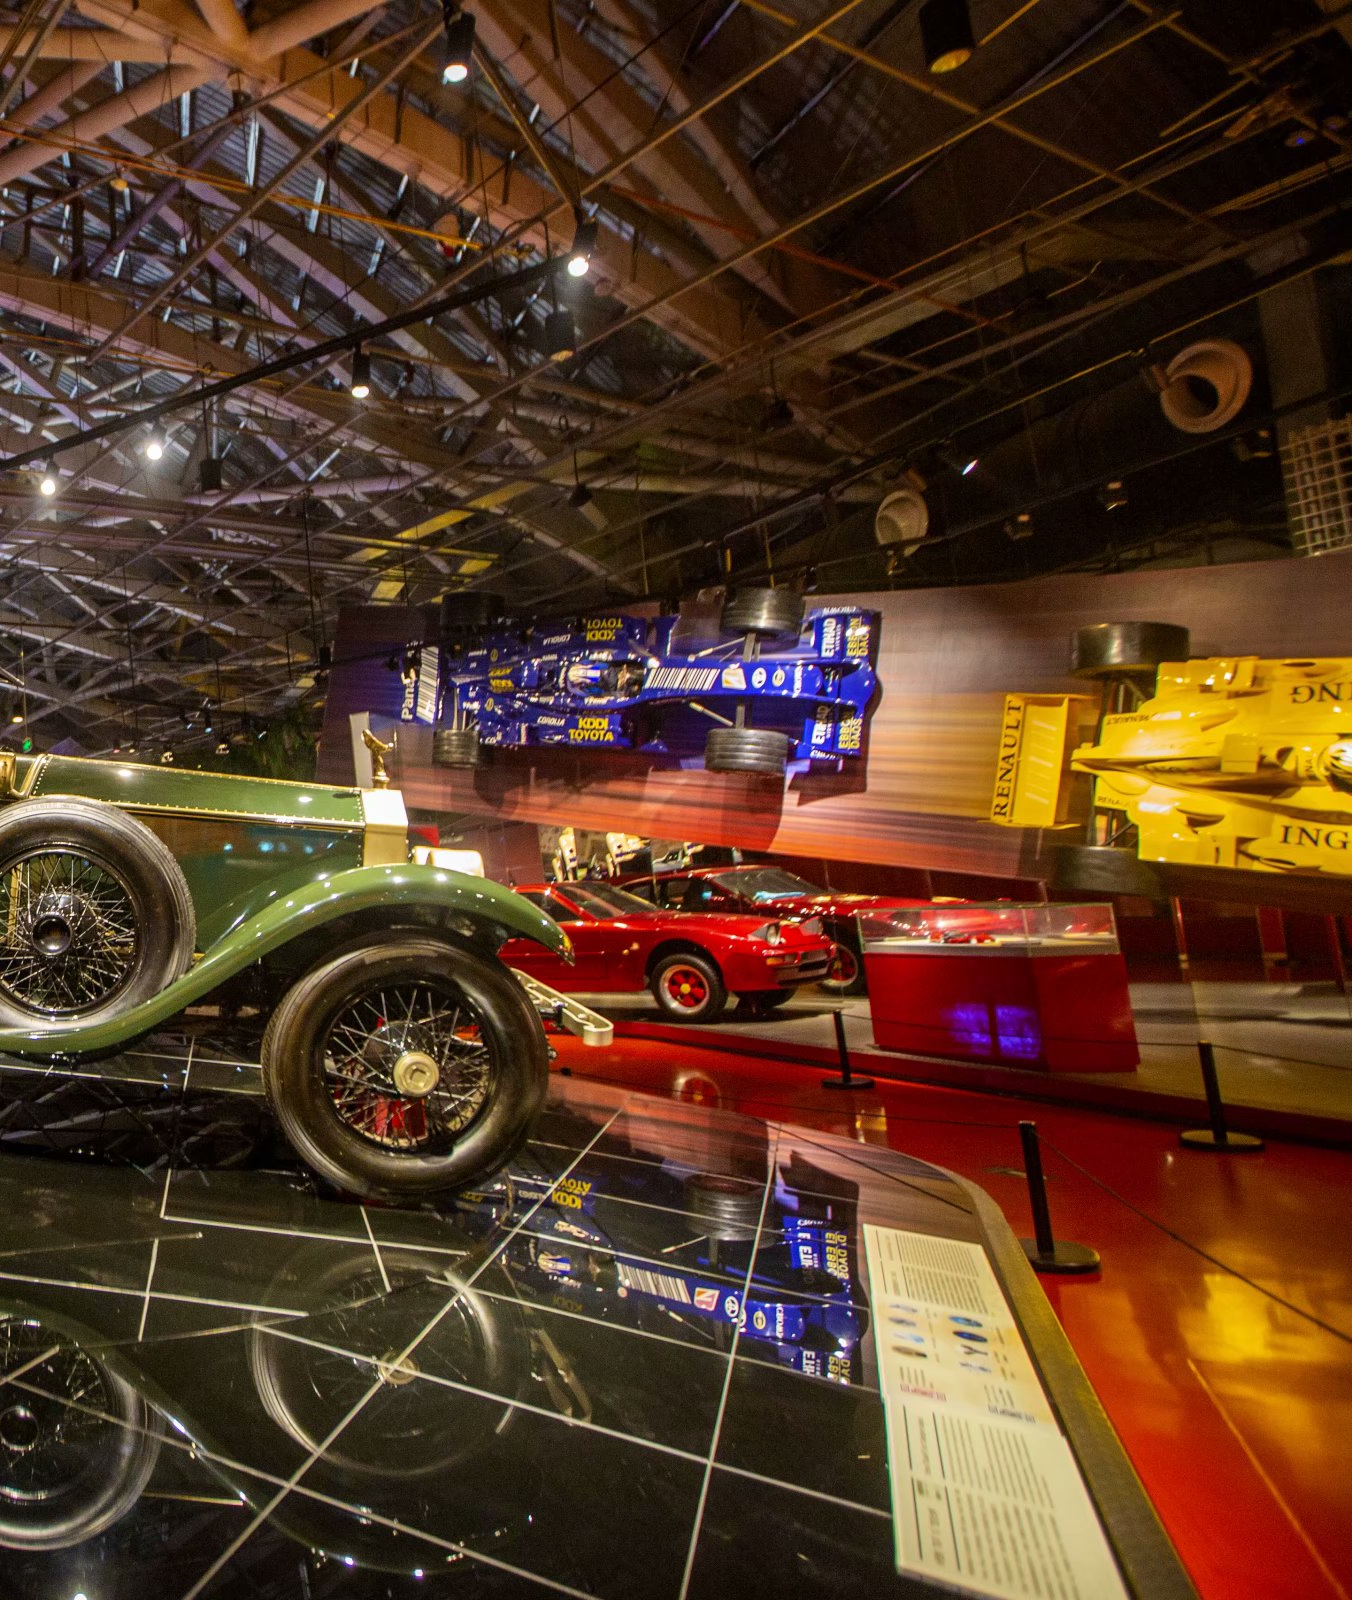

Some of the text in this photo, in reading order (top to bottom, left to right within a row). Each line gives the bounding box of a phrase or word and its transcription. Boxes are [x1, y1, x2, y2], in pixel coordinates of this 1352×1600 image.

[579, 717, 609, 730] KDDI
[569, 729, 614, 742] TOYOTA
[993, 700, 1021, 817] RENAULT
[1280, 824, 1350, 850] ING
